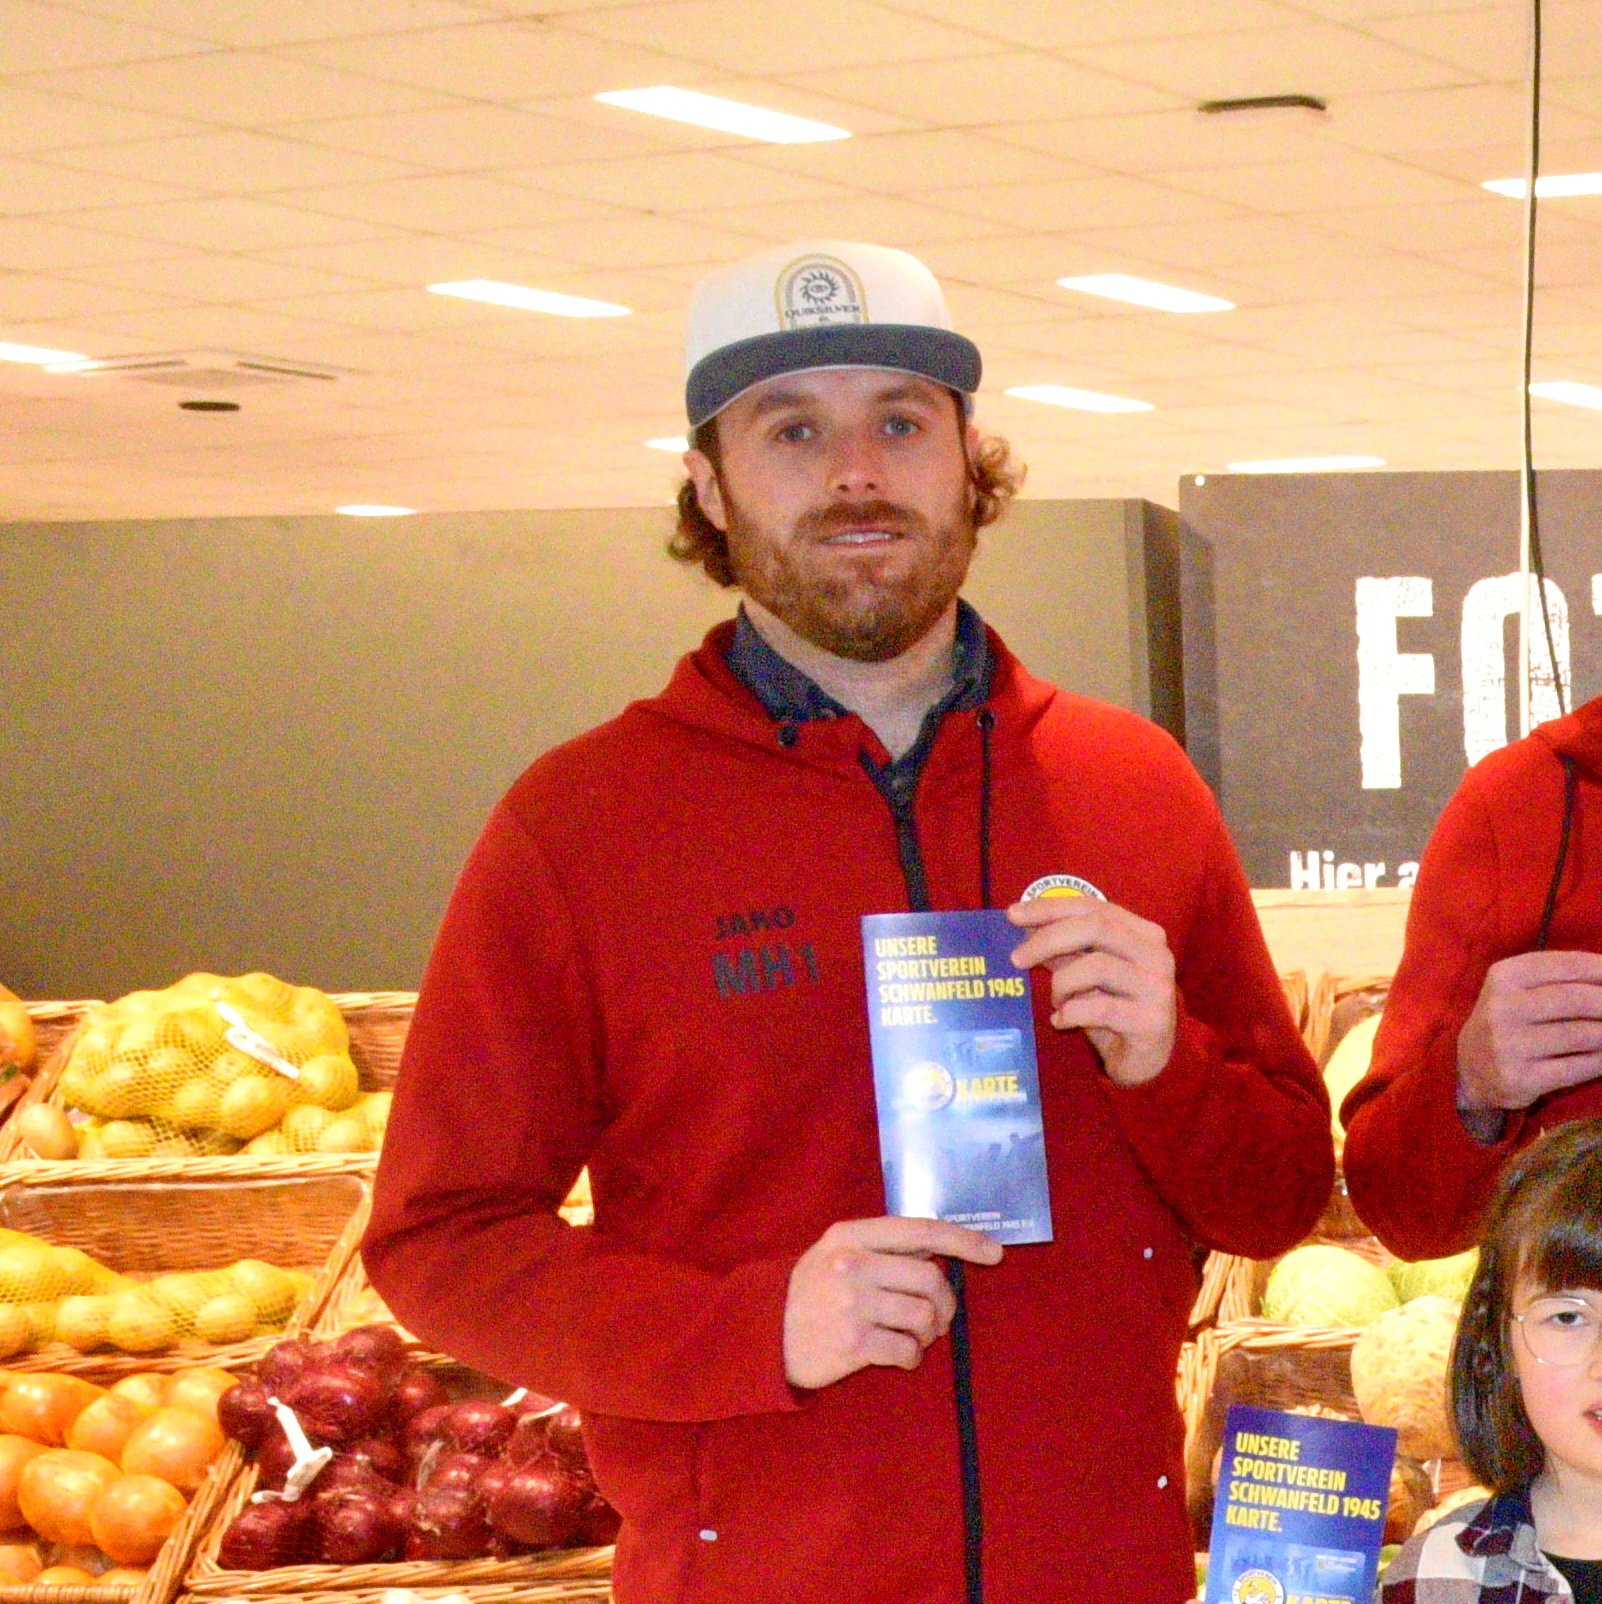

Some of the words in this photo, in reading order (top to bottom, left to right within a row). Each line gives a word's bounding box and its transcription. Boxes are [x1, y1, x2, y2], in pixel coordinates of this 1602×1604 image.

[785, 305, 860, 319] QUIKSILVER
[1289, 850, 1385, 889] Hier
[1026, 877, 1099, 899] SPORTVEREIN
[716, 906, 796, 940] JAKO
[875, 936, 937, 957] UNSERE
[877, 956, 986, 981] SPORTVEREIN
[878, 980, 985, 1003] SCHWANFELD
[988, 977, 1025, 998] 1945
[882, 1005, 938, 1026] KARTE.
[1235, 1432, 1300, 1461] UNSERE
[1231, 1457, 1347, 1492] SPORTVEREIN
[1229, 1480, 1340, 1516] SCHWANFELD
[1342, 1497, 1382, 1520] 1945
[1225, 1505, 1283, 1533] KARTE.
